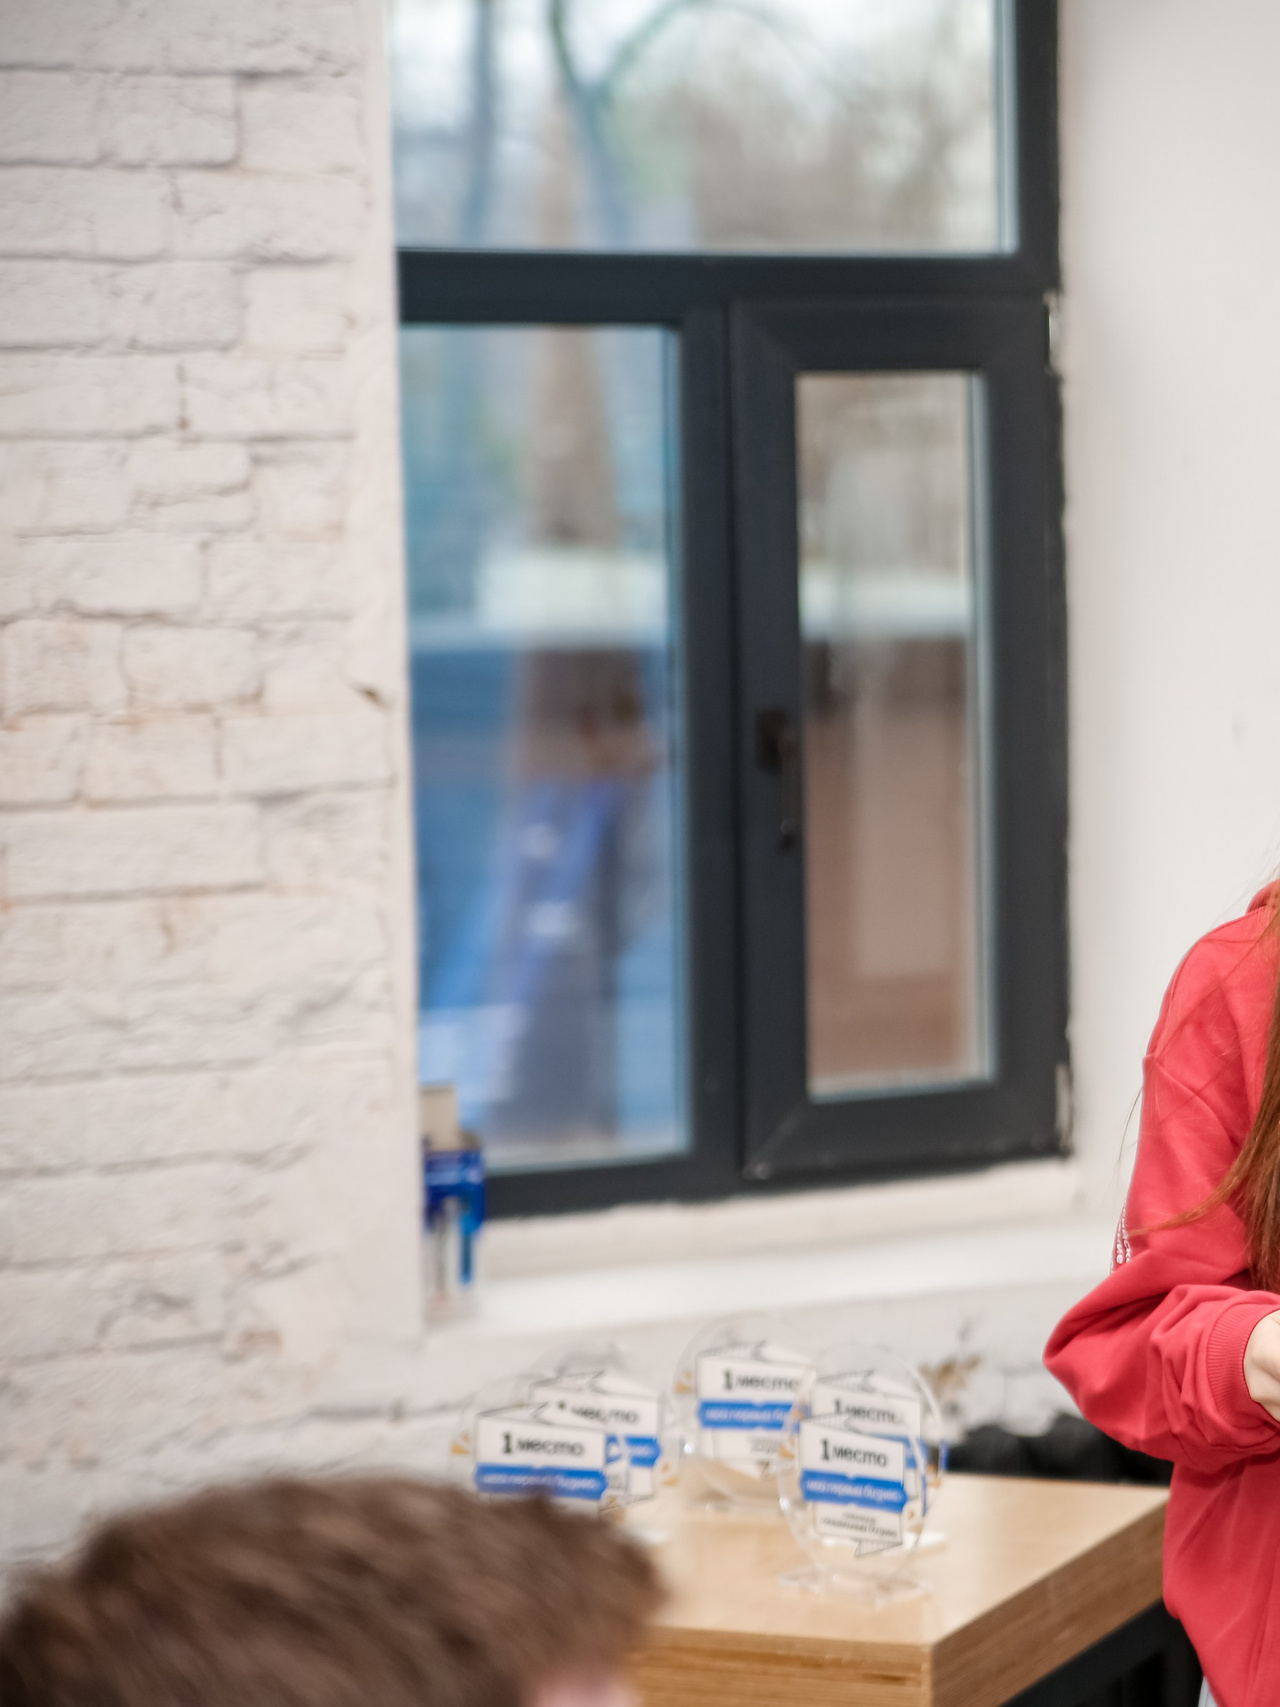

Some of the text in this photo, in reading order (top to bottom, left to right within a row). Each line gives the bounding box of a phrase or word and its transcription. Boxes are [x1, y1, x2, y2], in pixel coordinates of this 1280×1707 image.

[724, 1370, 733, 1392] 1
[503, 1433, 584, 1457] 1 место
[822, 1440, 887, 1468] 1 место
